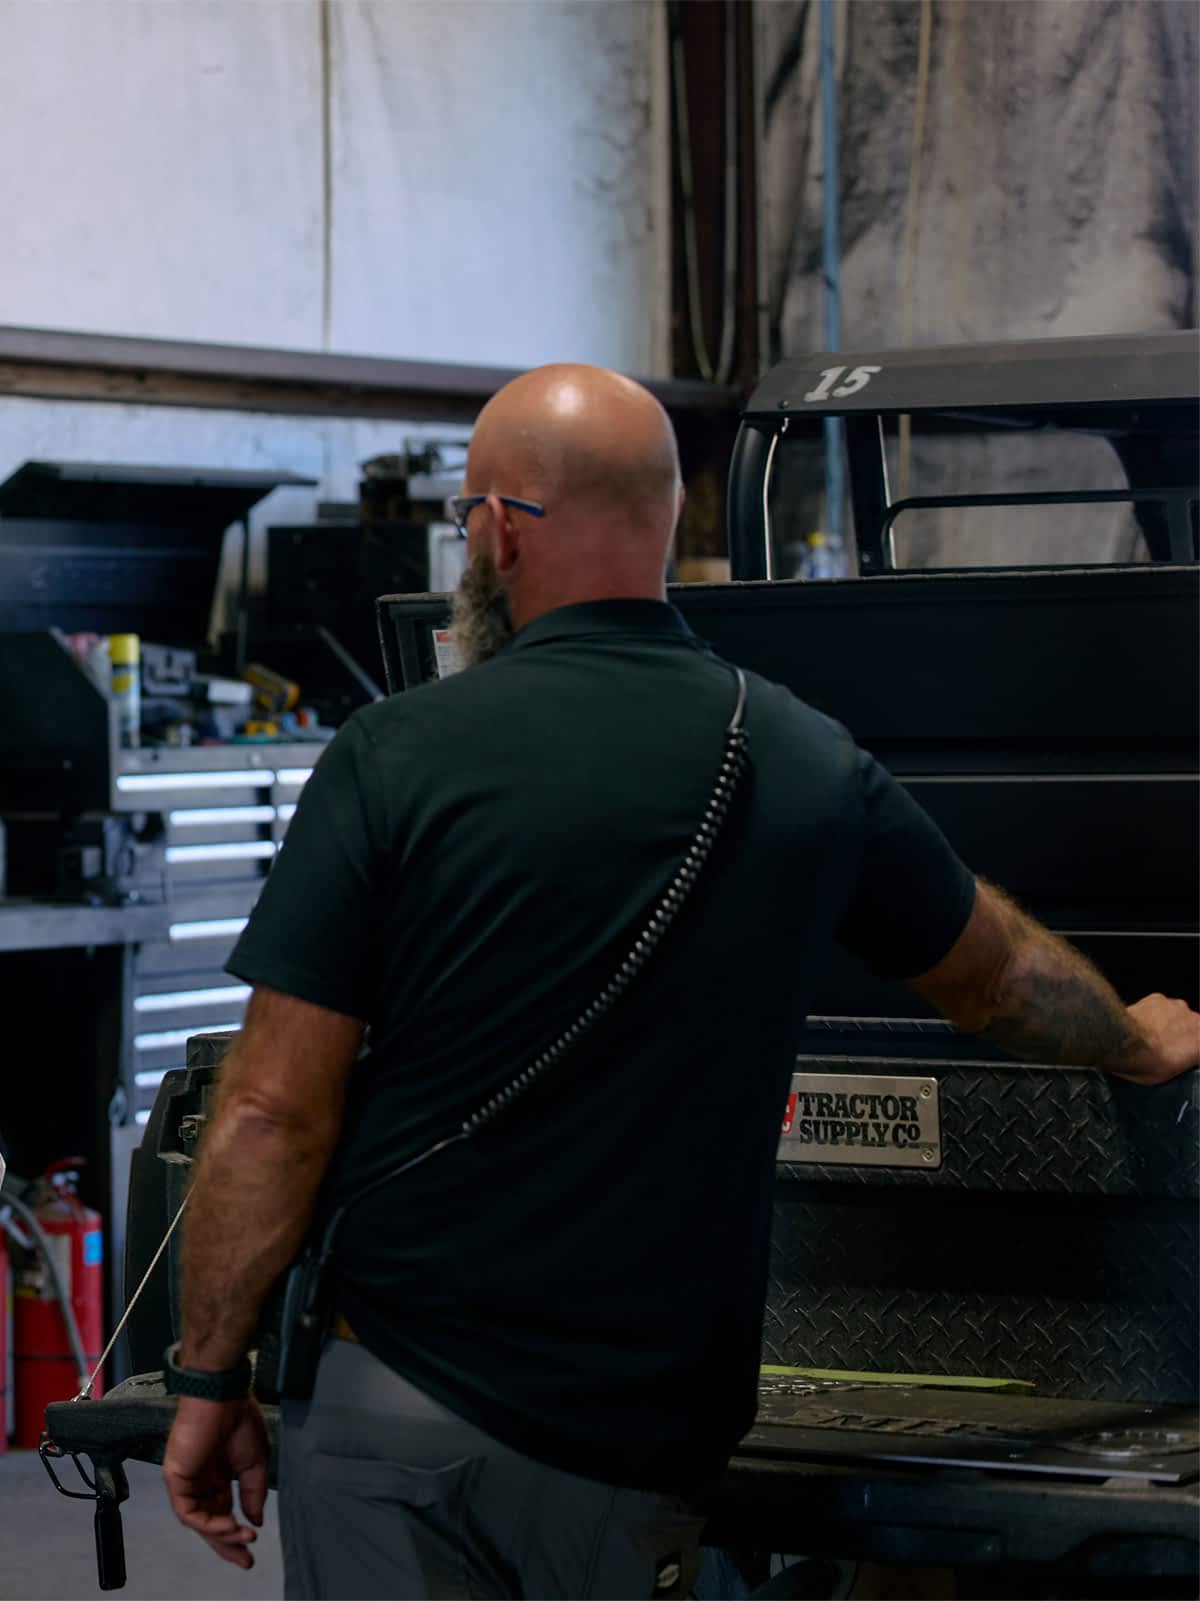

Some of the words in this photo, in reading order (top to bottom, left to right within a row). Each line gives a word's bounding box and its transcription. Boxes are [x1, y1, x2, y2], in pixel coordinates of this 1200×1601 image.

[804, 366, 882, 402] 15
[799, 1092, 918, 1121] TRACTOR
[800, 1119, 889, 1147] SUPPLY
